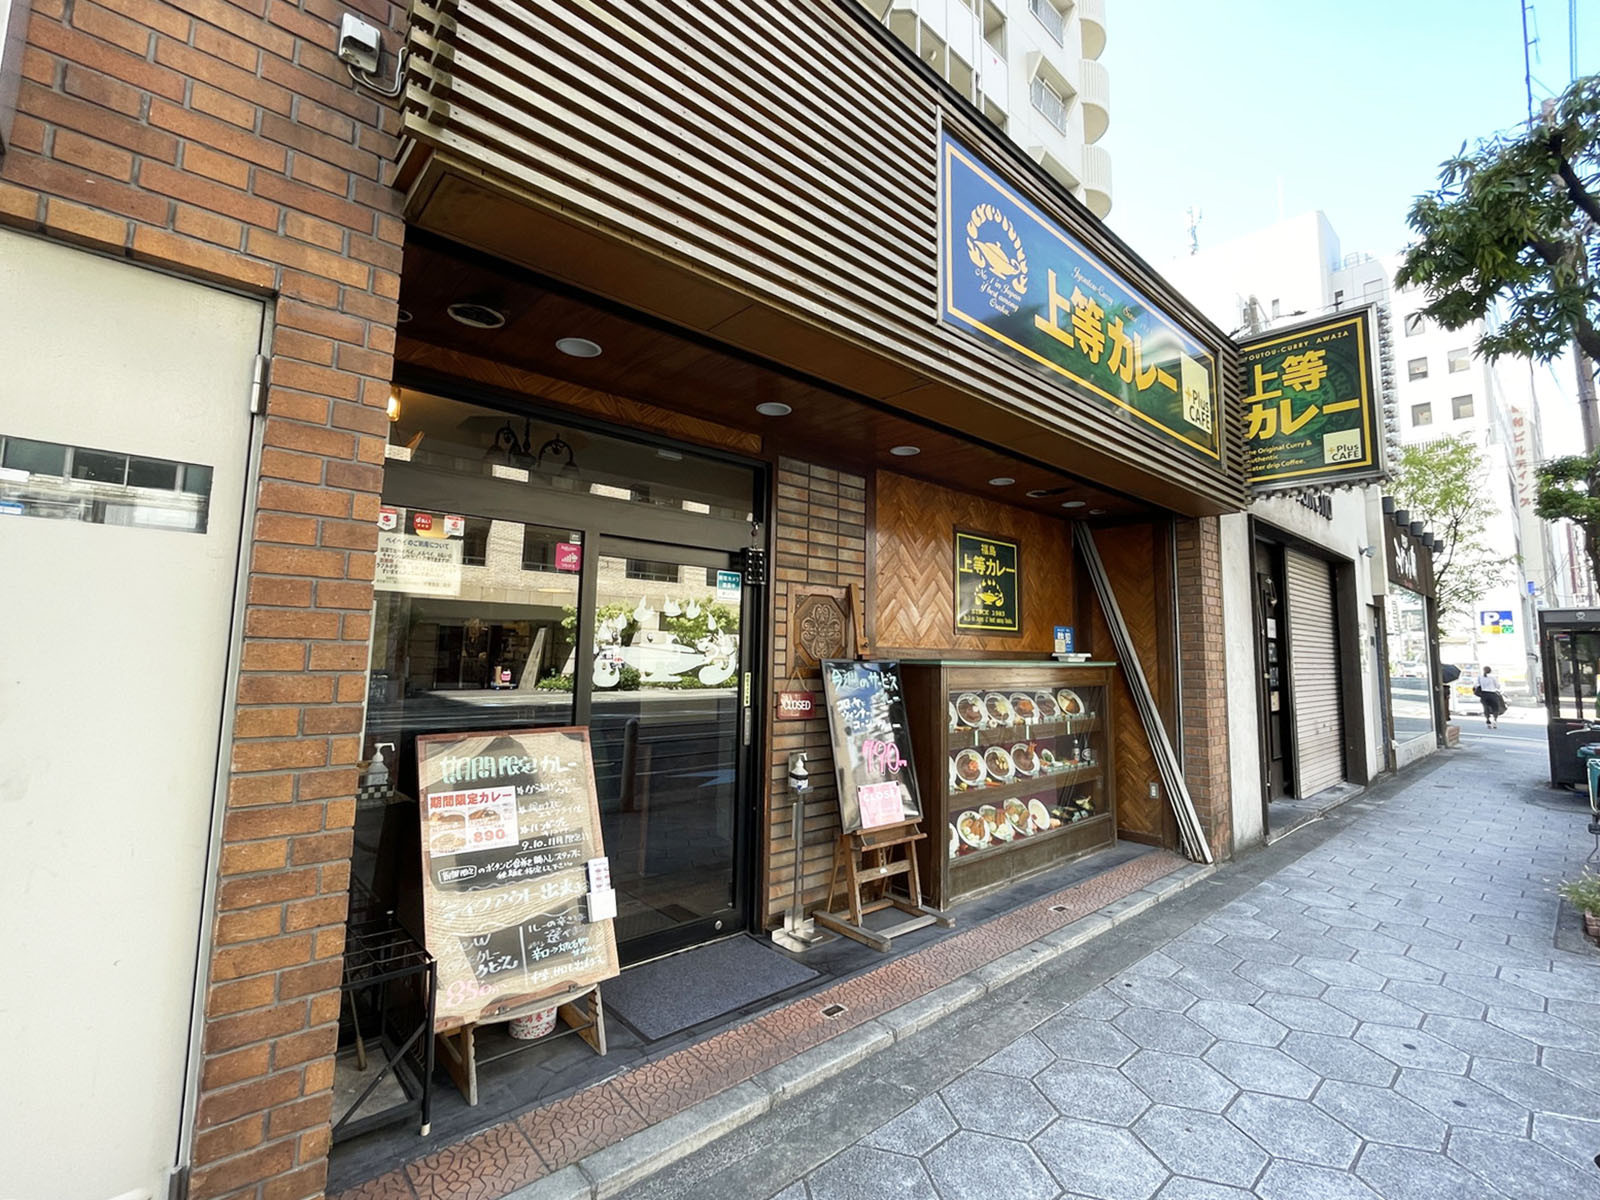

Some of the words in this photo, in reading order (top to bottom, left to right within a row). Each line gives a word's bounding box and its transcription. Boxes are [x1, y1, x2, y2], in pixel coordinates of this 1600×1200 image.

[1034, 268, 1178, 392] 上等カレー
[1315, 330, 1349, 345] AWAZA
[1242, 350, 1328, 404] 上等
[1189, 404, 1210, 430] CAFE
[1242, 398, 1360, 440] カレー
[1257, 443, 1285, 454] Original
[1285, 441, 1305, 450] Curry
[1331, 450, 1360, 461] CAFE
[959, 553, 1017, 576] 上等カレー
[1483, 612, 1500, 626] P
[784, 699, 811, 711] CLOSED
[430, 792, 513, 809] 期間限定カレー
[473, 828, 505, 844] 890
[475, 955, 519, 978] うどん
